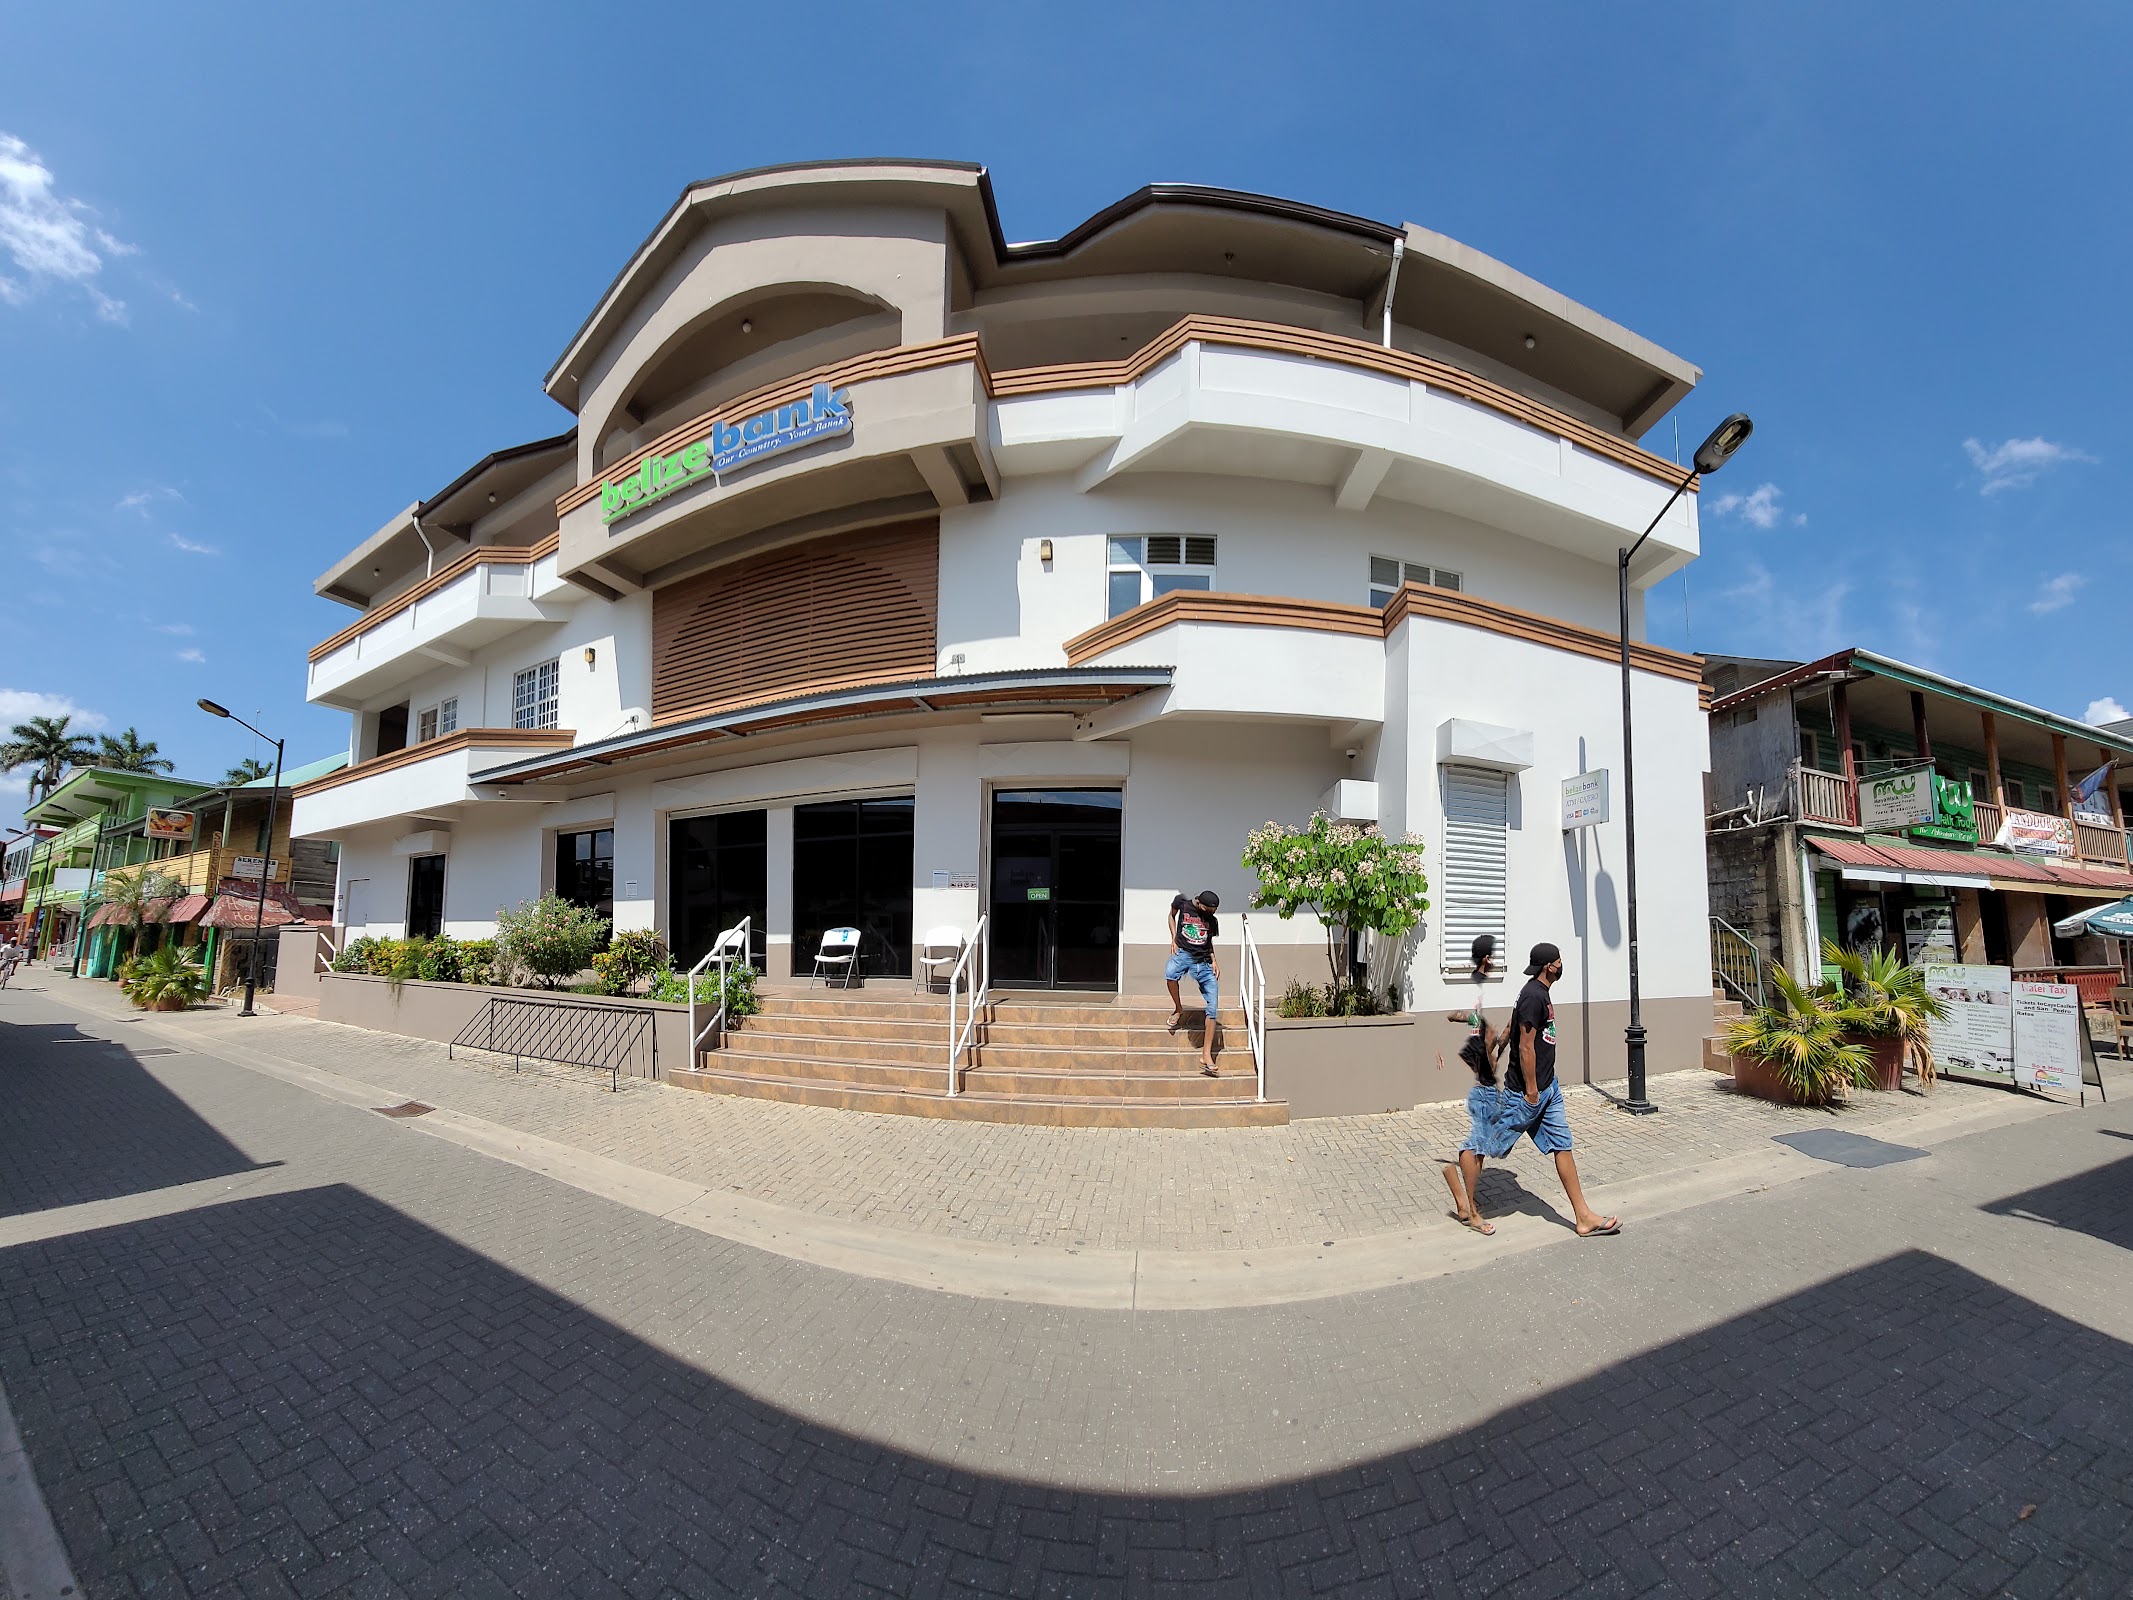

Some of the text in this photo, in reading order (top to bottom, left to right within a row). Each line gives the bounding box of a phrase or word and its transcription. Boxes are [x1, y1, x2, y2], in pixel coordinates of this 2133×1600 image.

[717, 454, 735, 467] Our
[789, 426, 812, 440] Your
[208, 832, 221, 897] SERENDIB
[2048, 985, 2068, 994] Taxi
